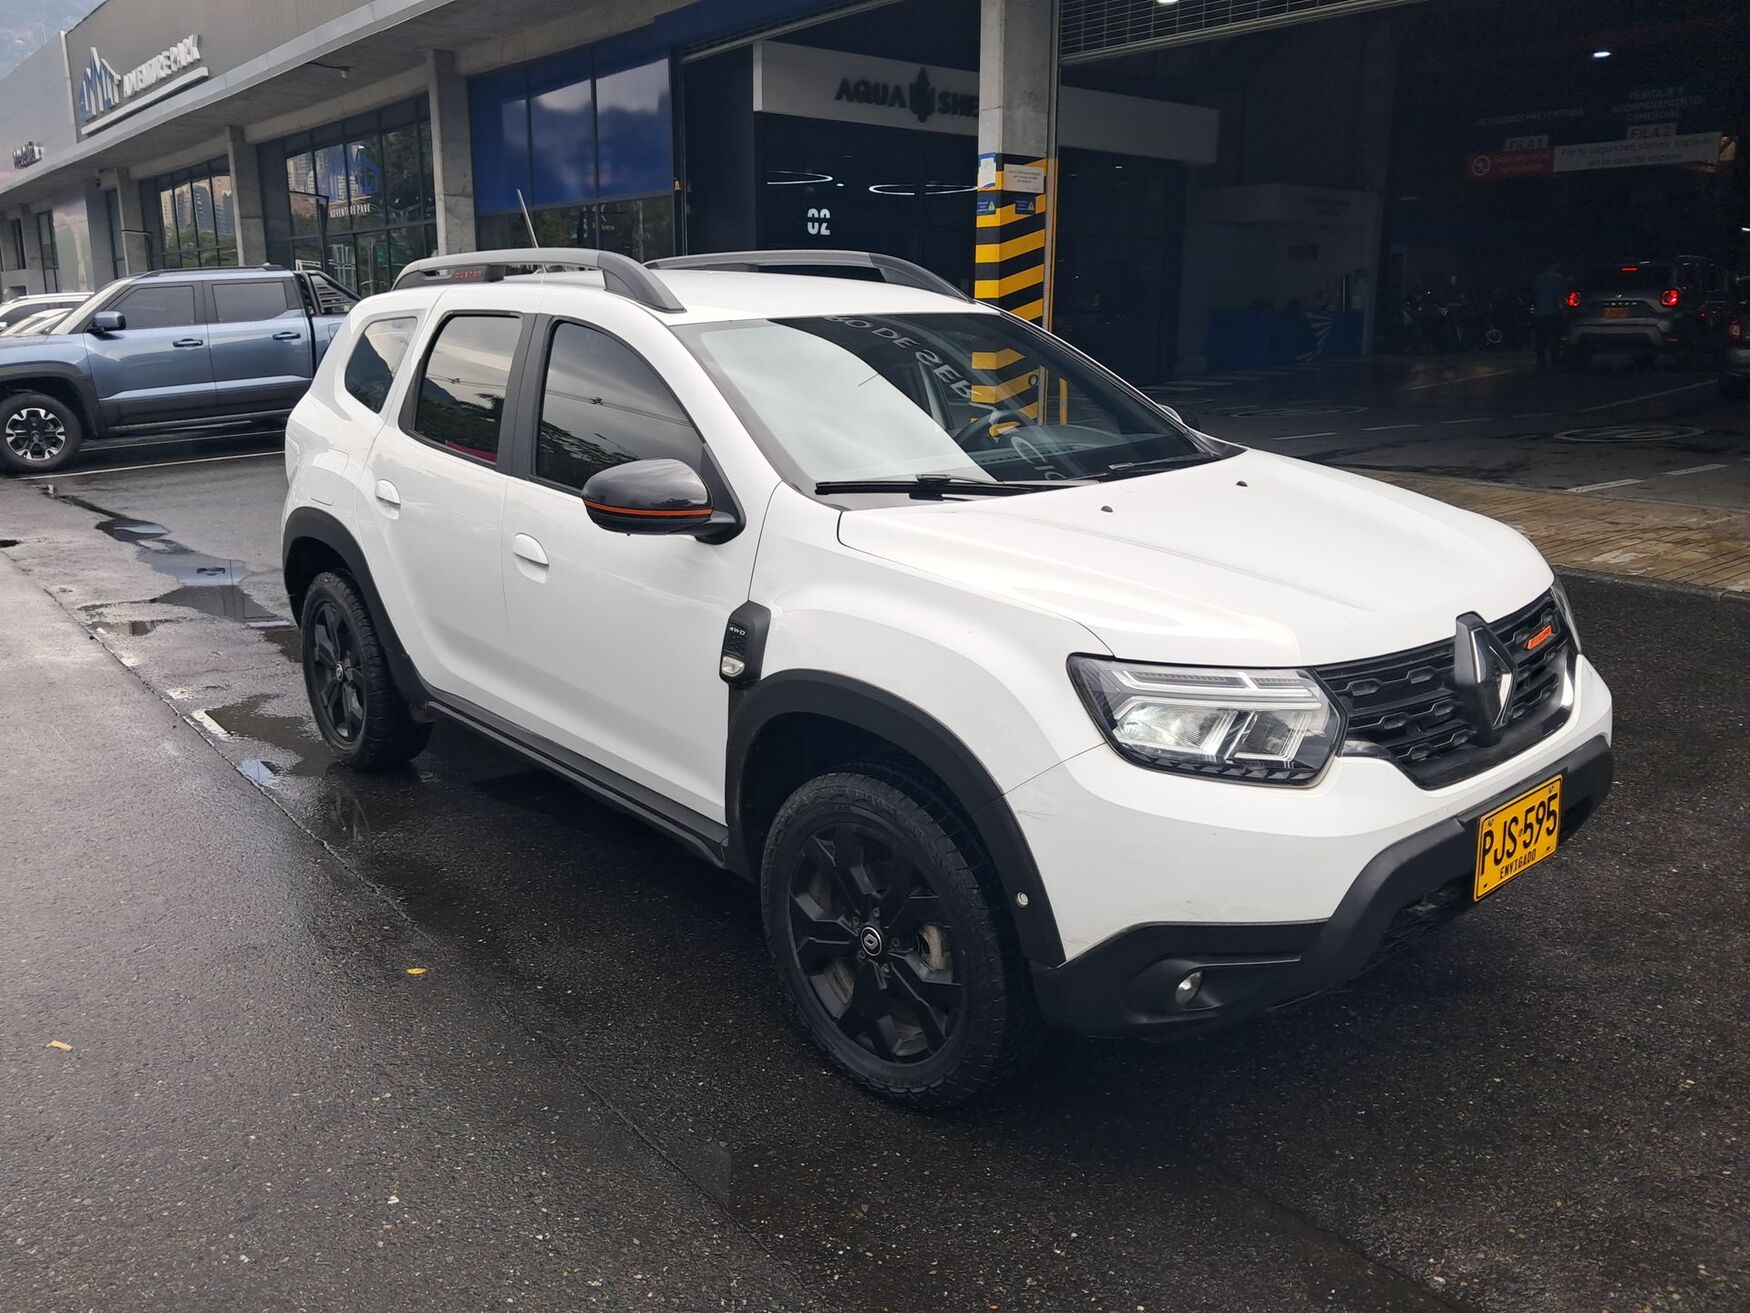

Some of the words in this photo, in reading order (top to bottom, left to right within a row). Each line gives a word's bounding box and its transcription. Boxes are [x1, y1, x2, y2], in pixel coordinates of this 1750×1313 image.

[835, 77, 907, 108] AQUA
[807, 208, 831, 235] 02
[728, 626, 746, 637] 4WD
[1500, 848, 1537, 880] ENVIGADO
